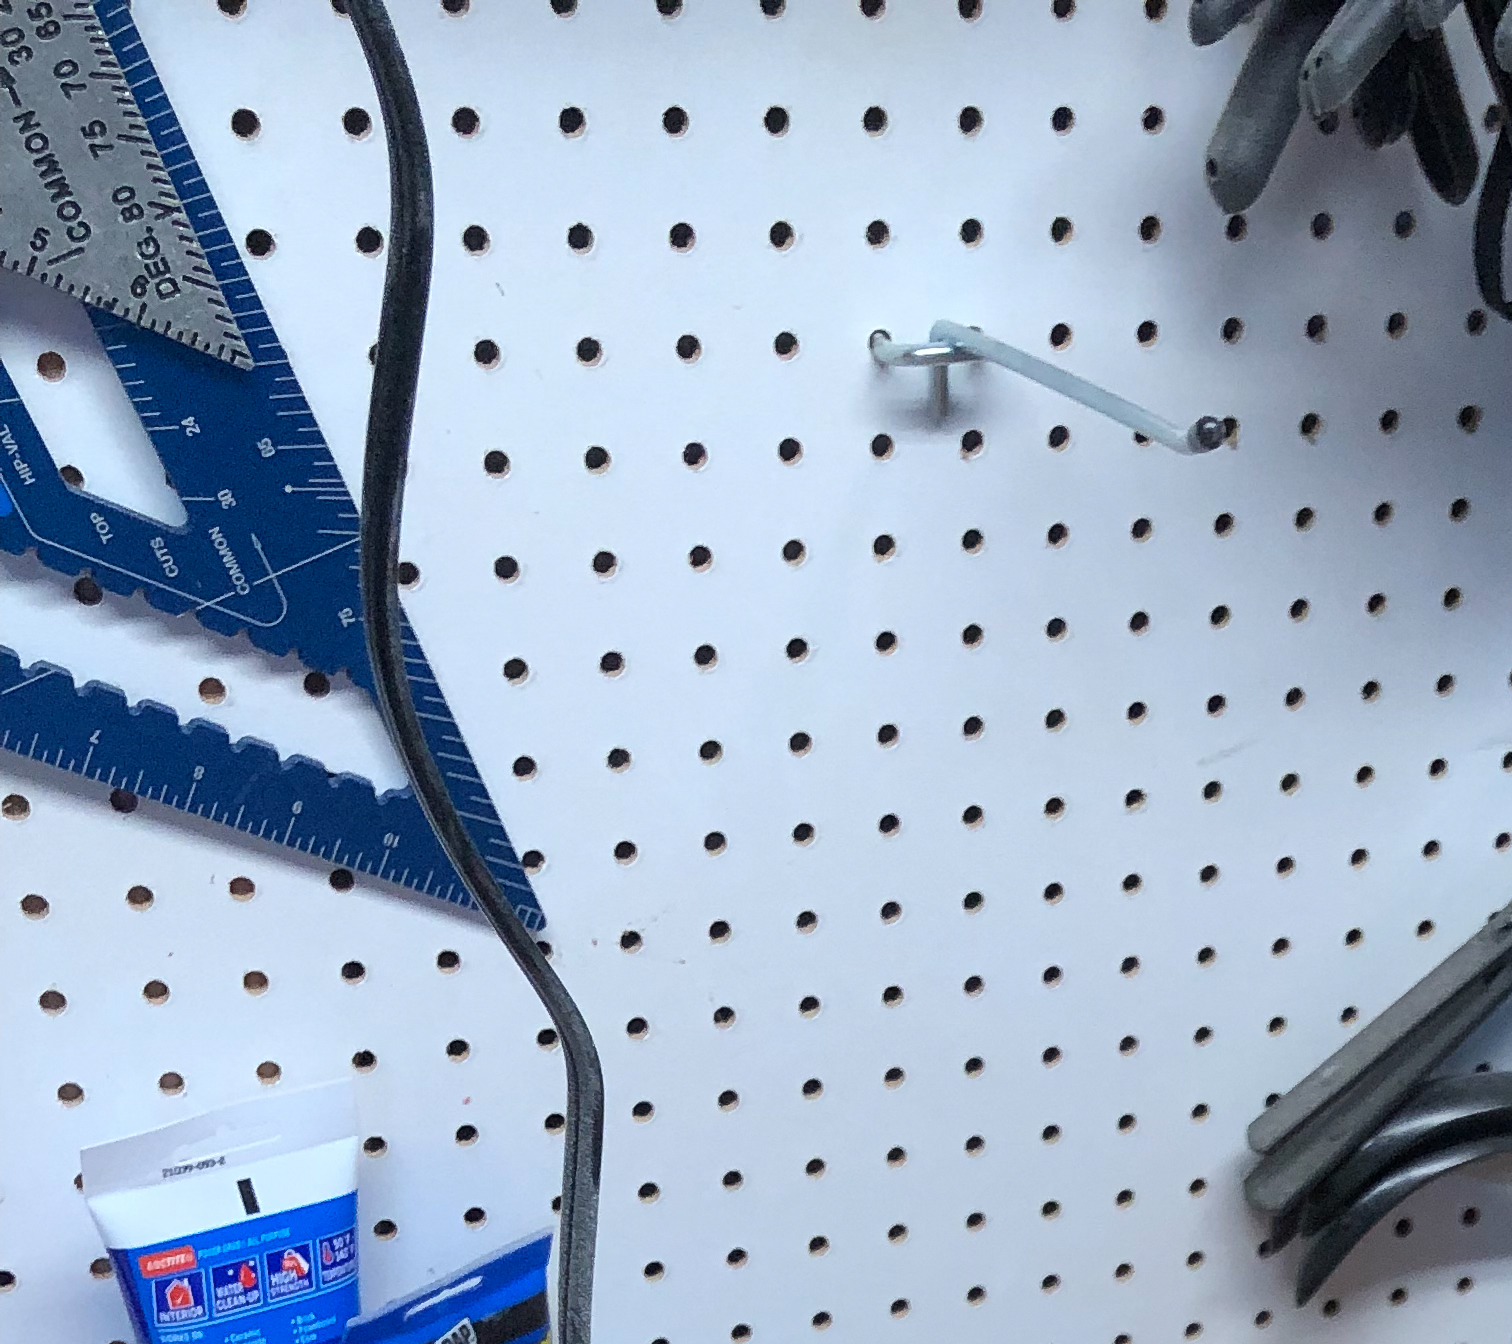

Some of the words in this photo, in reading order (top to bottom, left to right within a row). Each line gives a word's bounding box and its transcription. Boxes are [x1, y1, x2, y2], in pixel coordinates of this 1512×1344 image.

[0, 27, 34, 66] 30
[53, 59, 87, 100] 70
[80, 119, 115, 160] 75
[12, 110, 92, 243] COMMON
[112, 185, 144, 223] 80
[136, 225, 181, 300] DEG.
[181, 416, 201, 437] 24
[217, 488, 237, 510] 30
[89, 512, 114, 545] TOP
[150, 536, 180, 579] CUTS
[208, 526, 251, 596] COMMON
[193, 765, 206, 780] 8
[383, 832, 400, 849] 10
